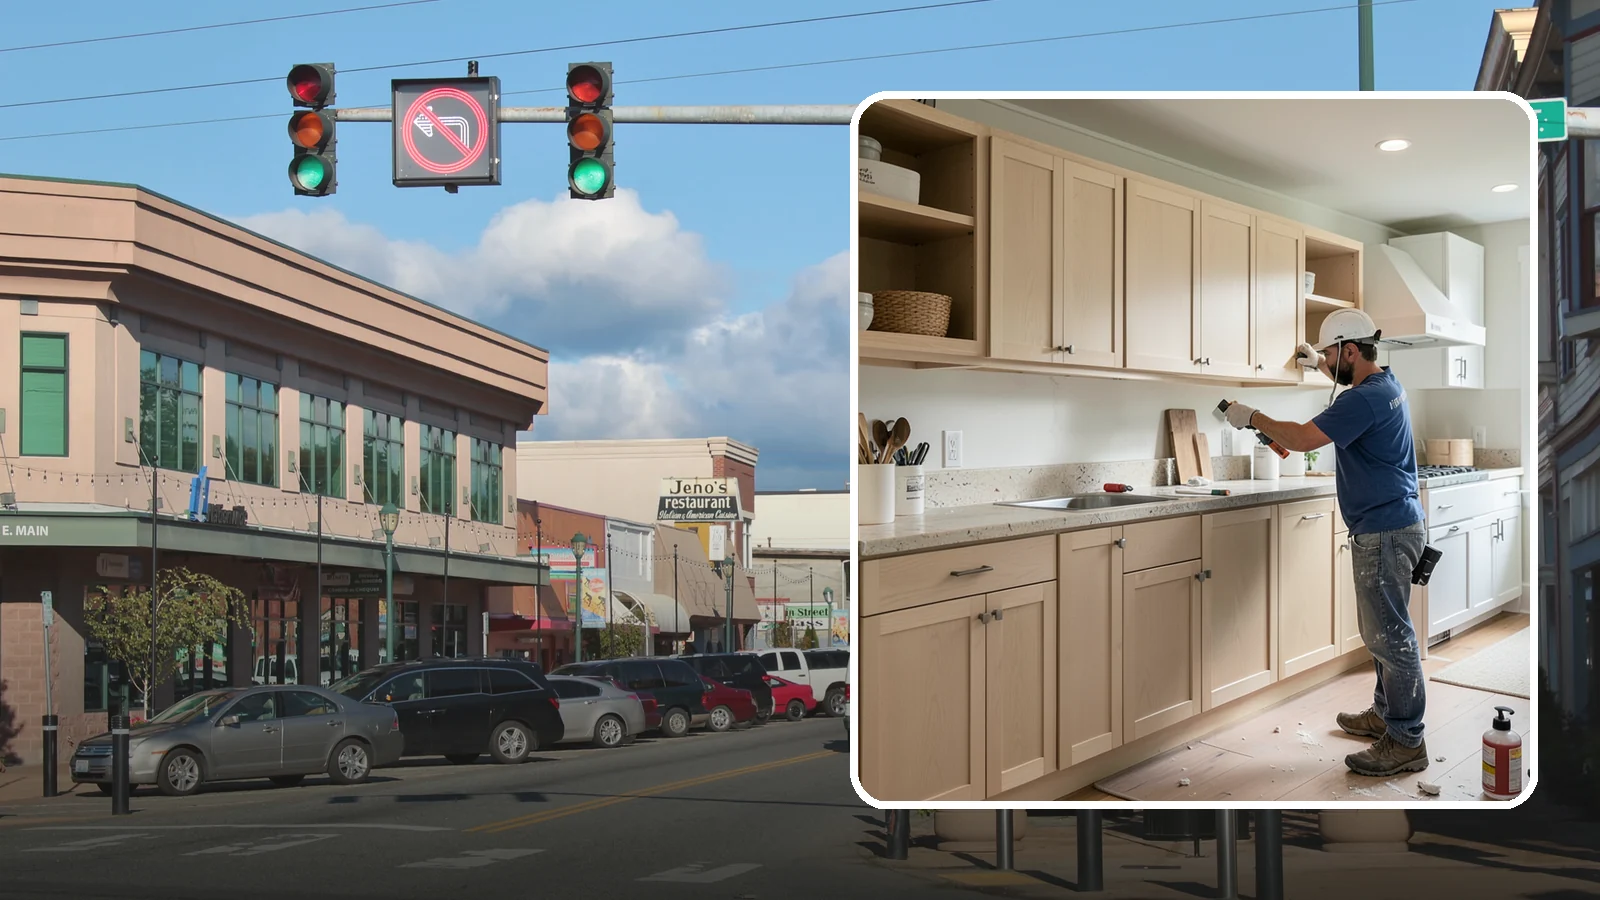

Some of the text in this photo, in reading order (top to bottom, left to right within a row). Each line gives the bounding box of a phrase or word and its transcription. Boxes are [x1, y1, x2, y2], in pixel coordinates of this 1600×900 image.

[669, 479, 728, 494] Jeno's
[664, 495, 731, 509] restaurant
[658, 510, 682, 520] Italian
[686, 509, 714, 520] American
[714, 509, 738, 520] Cuisine
[2, 525, 49, 536] E. MAIN
[797, 606, 829, 617] Street
